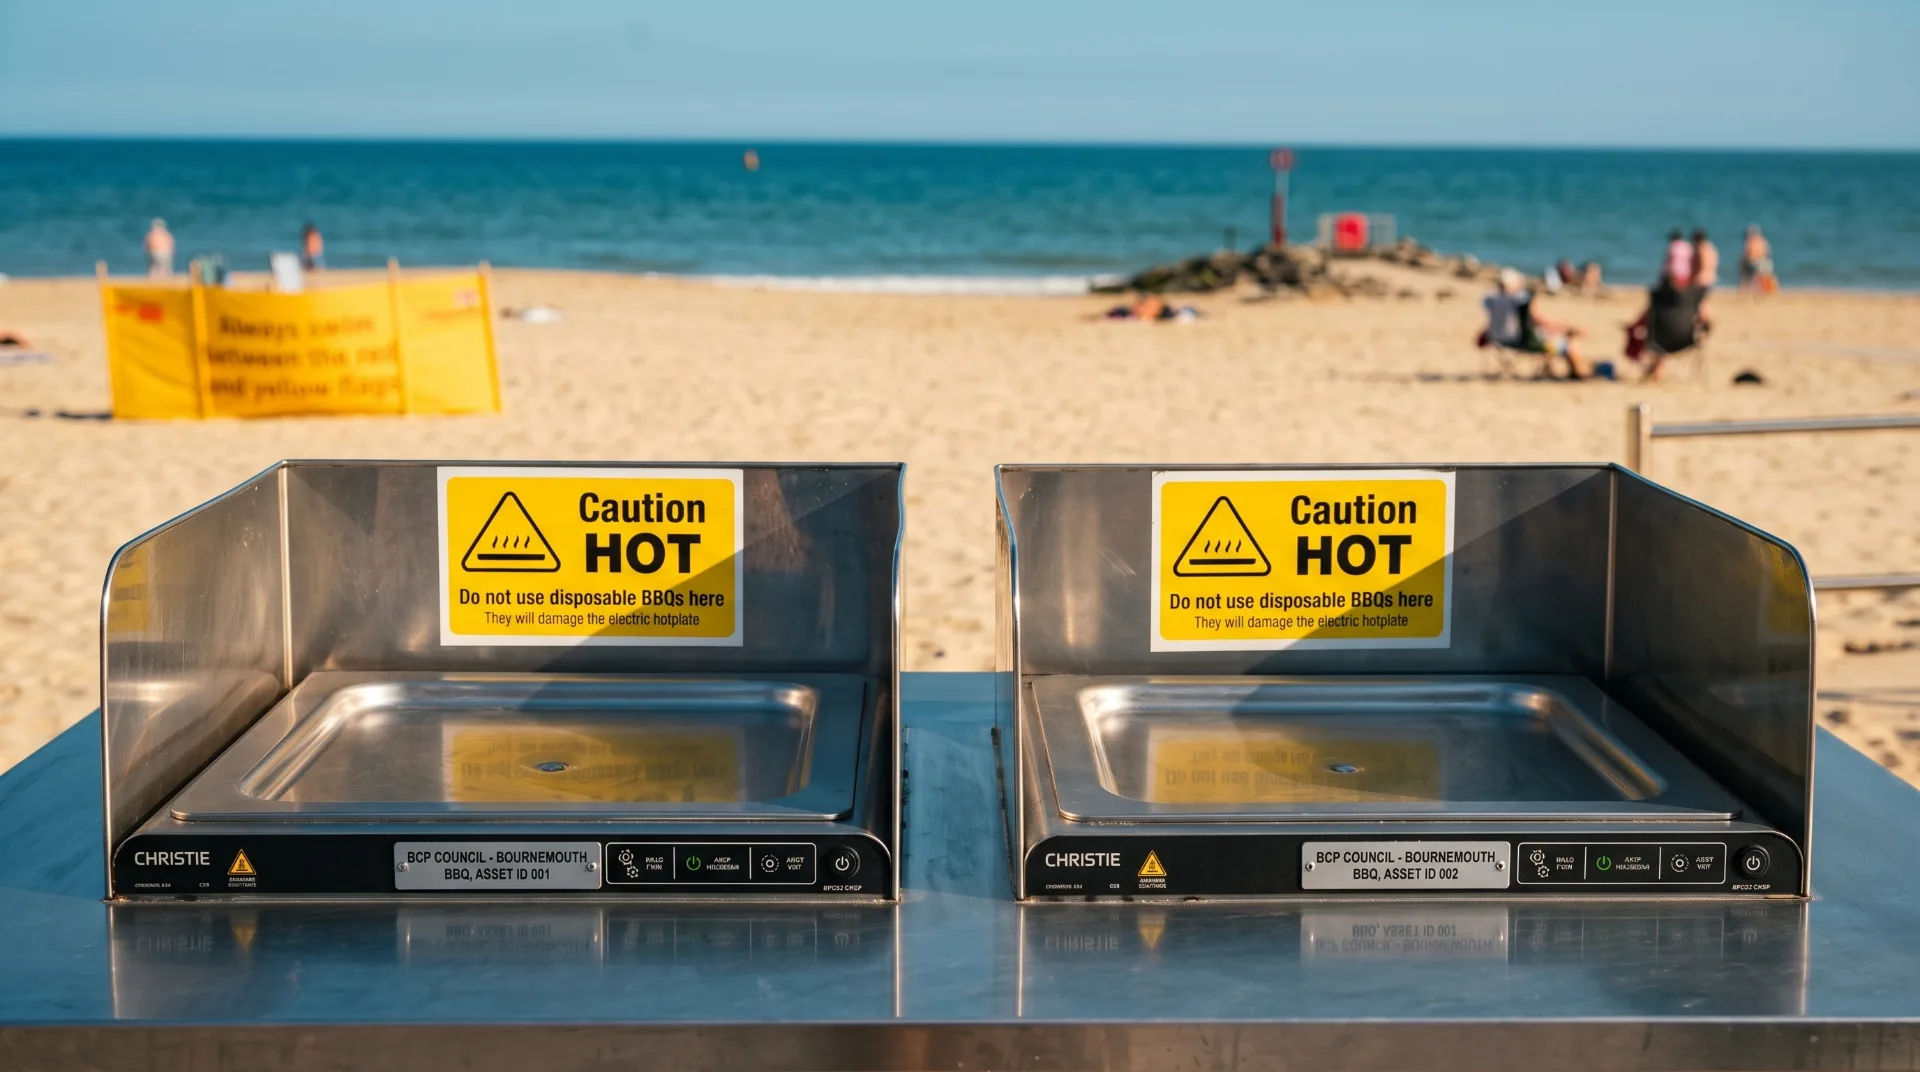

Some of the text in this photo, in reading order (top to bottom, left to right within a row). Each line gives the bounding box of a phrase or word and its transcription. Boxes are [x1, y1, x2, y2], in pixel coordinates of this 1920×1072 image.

[579, 492, 705, 523] Caution
[1291, 494, 1417, 525] Caution
[585, 532, 701, 575] HOT
[1296, 534, 1412, 576] HOT
[460, 589, 725, 609] Do not use disposable BBQs here
[1170, 591, 1433, 612] Do not use disposable BBQs here
[484, 612, 700, 628] They will damage the electric hotplate
[1194, 614, 1409, 632] They will damage the electric hotplate
[135, 852, 210, 866] CHRISTIE
[407, 851, 431, 863] BCP
[435, 851, 487, 863] COUNCIL
[497, 851, 588, 863] BOURNEMOUTH
[1045, 853, 1120, 867] CHRISTIE
[1316, 851, 1340, 863] BCP
[1344, 851, 1395, 863] COUNCIL
[1405, 851, 1496, 863] BOURNEMOUTH
[444, 868, 550, 882] BBQ, ASSET ID 001
[1353, 868, 1458, 882] BBQ, ASSET ID 002
